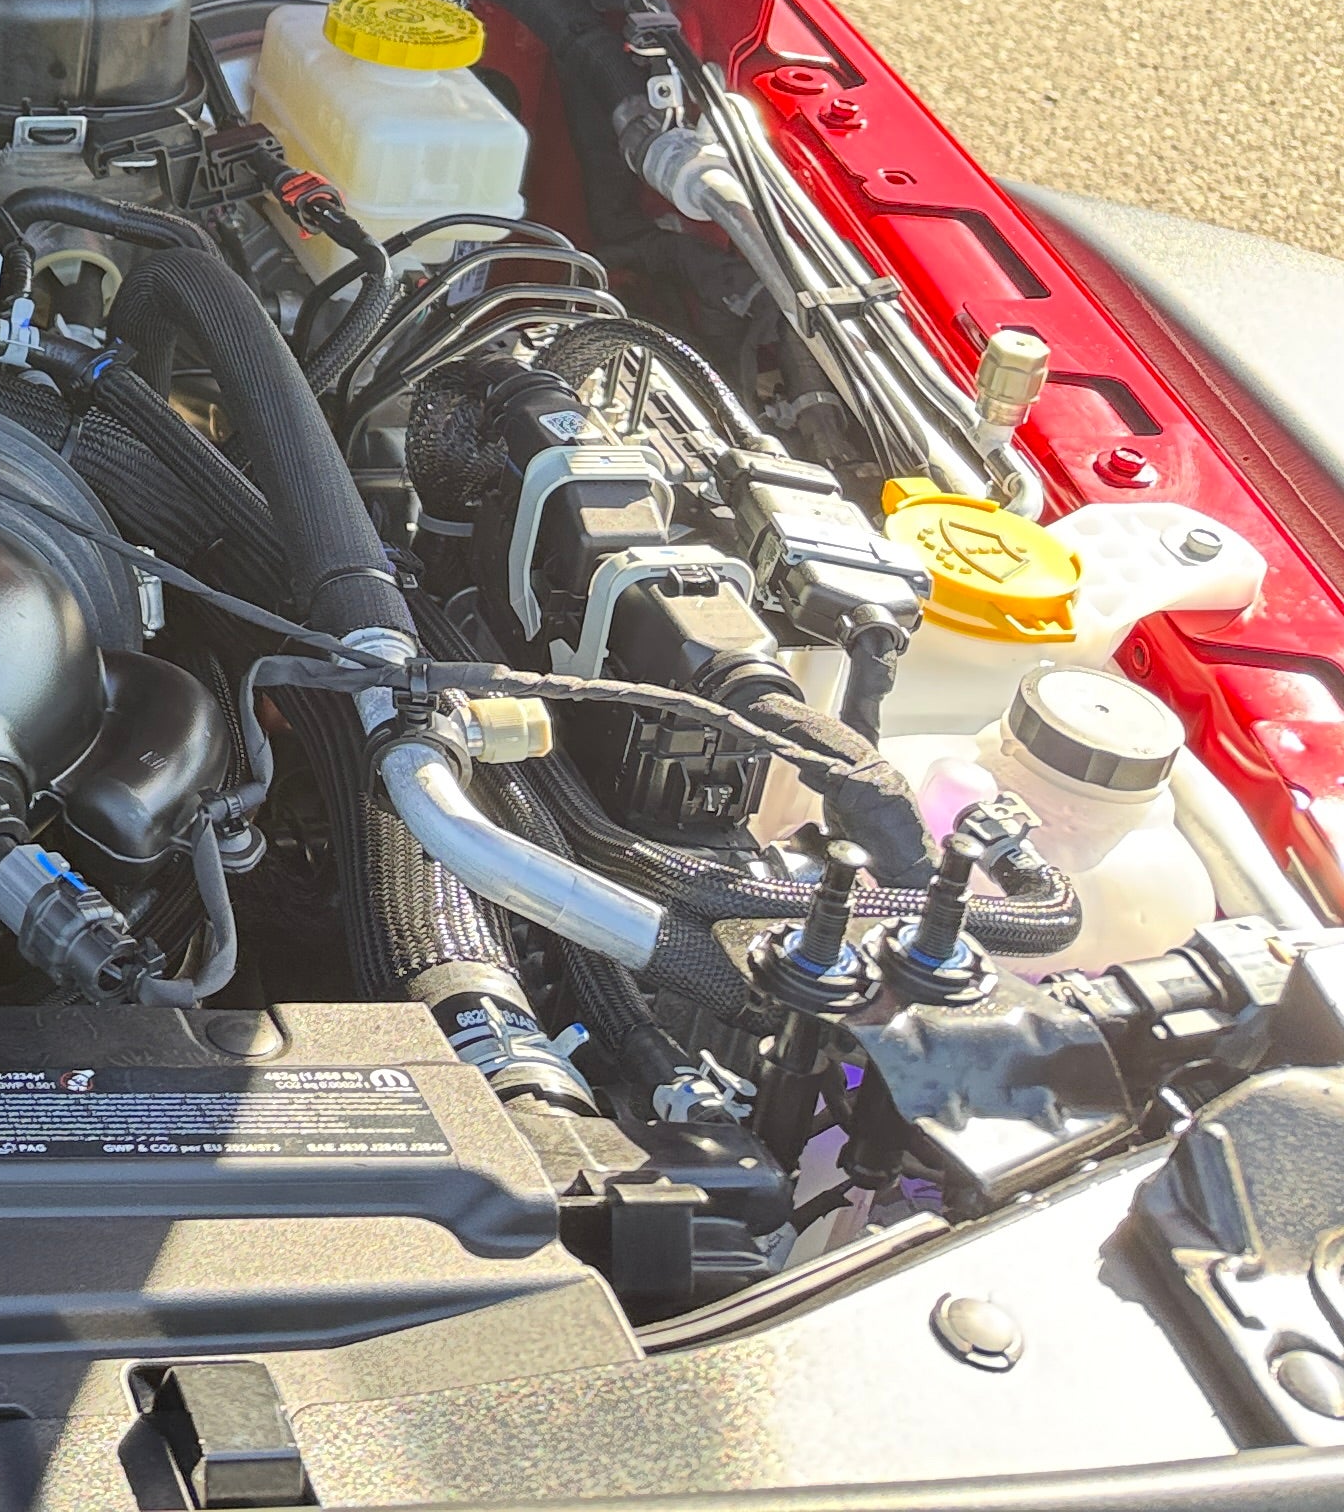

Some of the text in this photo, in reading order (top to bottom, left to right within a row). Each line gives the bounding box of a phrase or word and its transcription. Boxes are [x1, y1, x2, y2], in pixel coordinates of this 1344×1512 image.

[17, 1143, 47, 1153] PAG
[102, 1143, 135, 1153] GWP
[149, 1143, 179, 1153] CO2
[180, 1145, 201, 1154] per
[202, 1143, 223, 1153] EU
